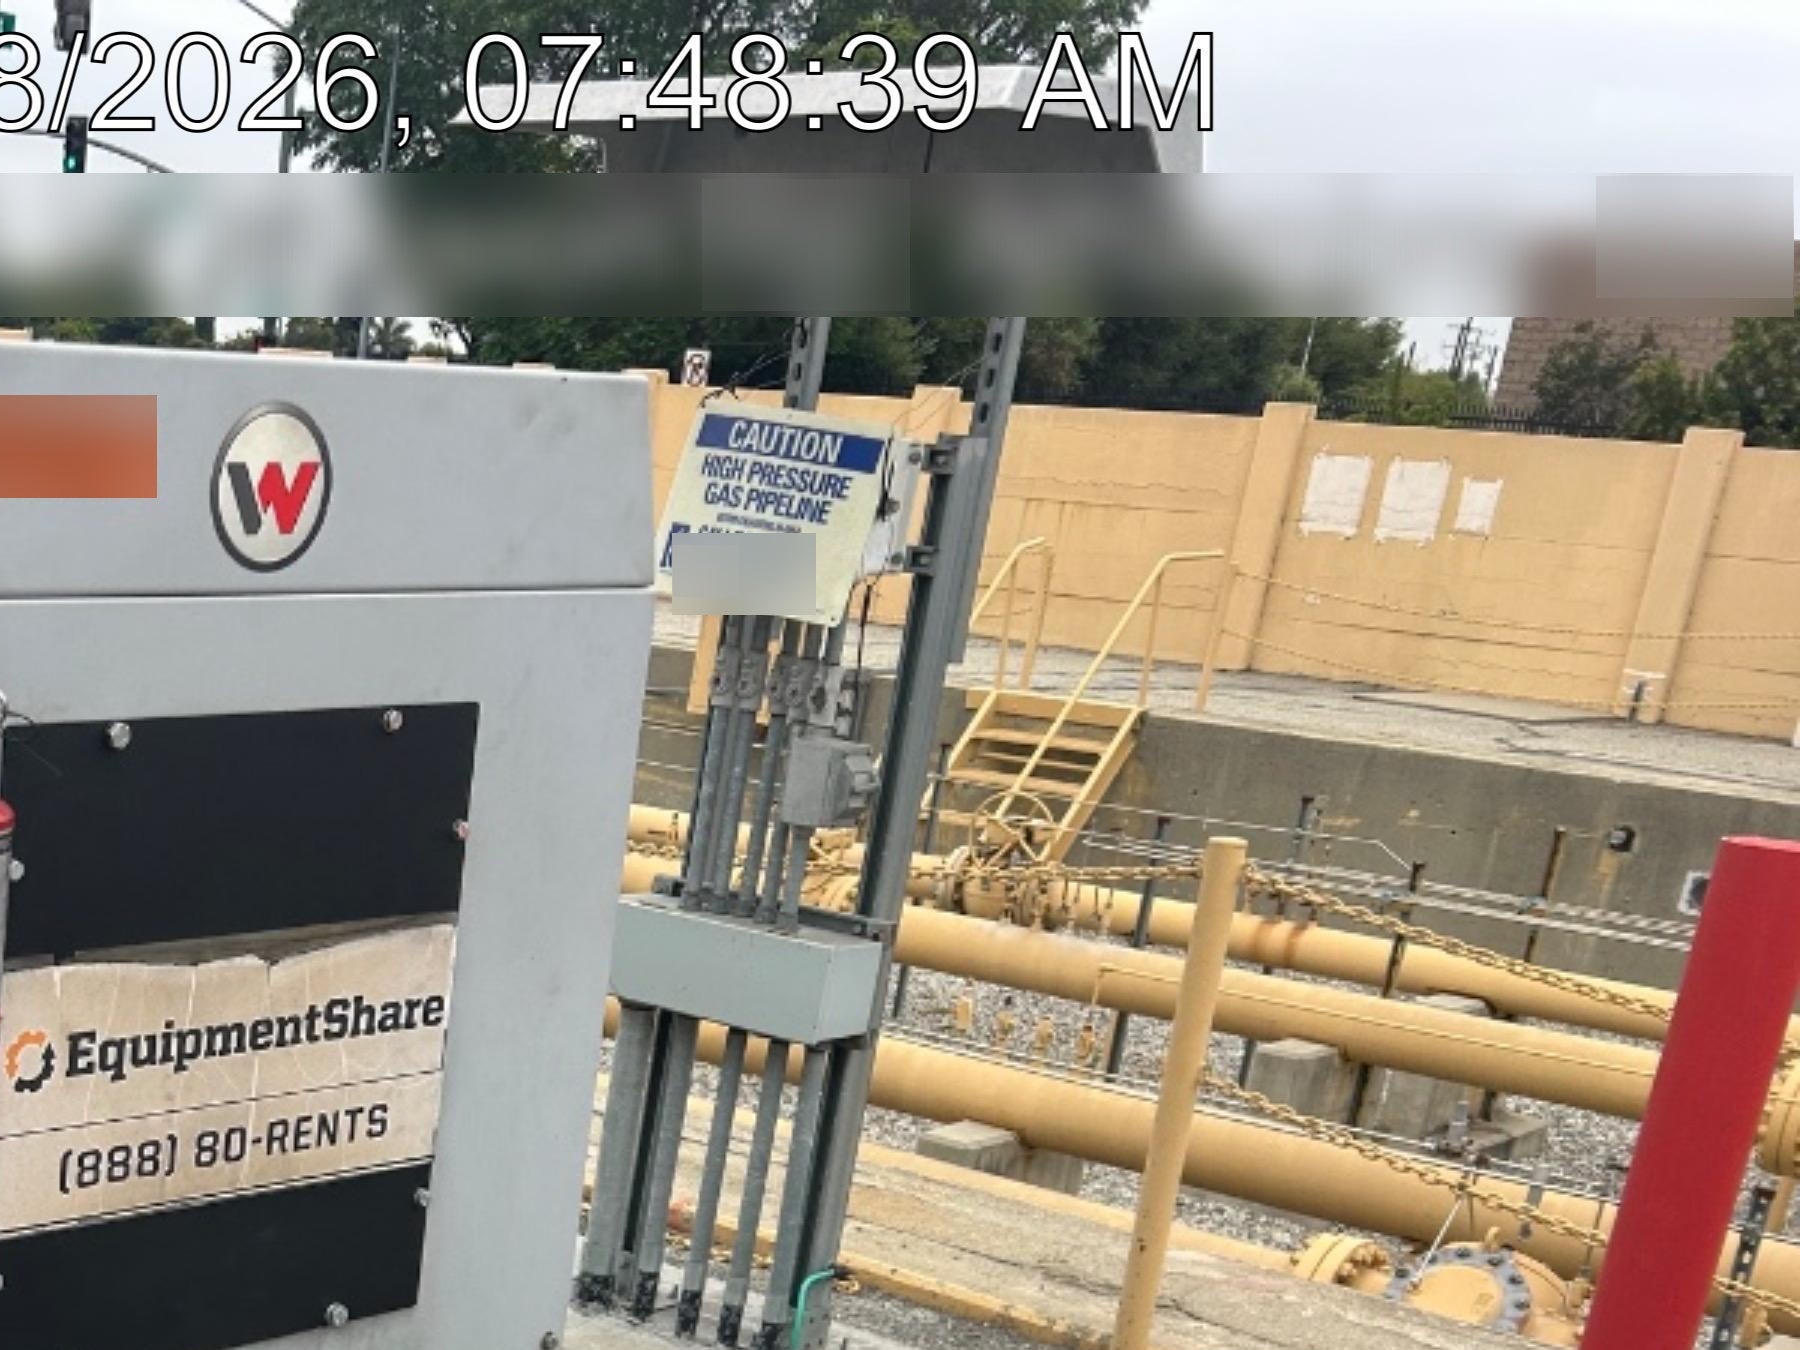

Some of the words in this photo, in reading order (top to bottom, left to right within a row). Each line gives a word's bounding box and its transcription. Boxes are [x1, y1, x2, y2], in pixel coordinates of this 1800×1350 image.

[727, 419, 844, 463] CAUTION
[701, 454, 748, 482] HIGH
[747, 461, 854, 499] PRESSURE
[704, 482, 744, 508] GAS
[744, 488, 833, 525] PIPELINE
[65, 994, 445, 1081] EquipmentShare
[59, 1134, 176, 1195] (888)
[195, 1104, 389, 1168] 80-RENTS
